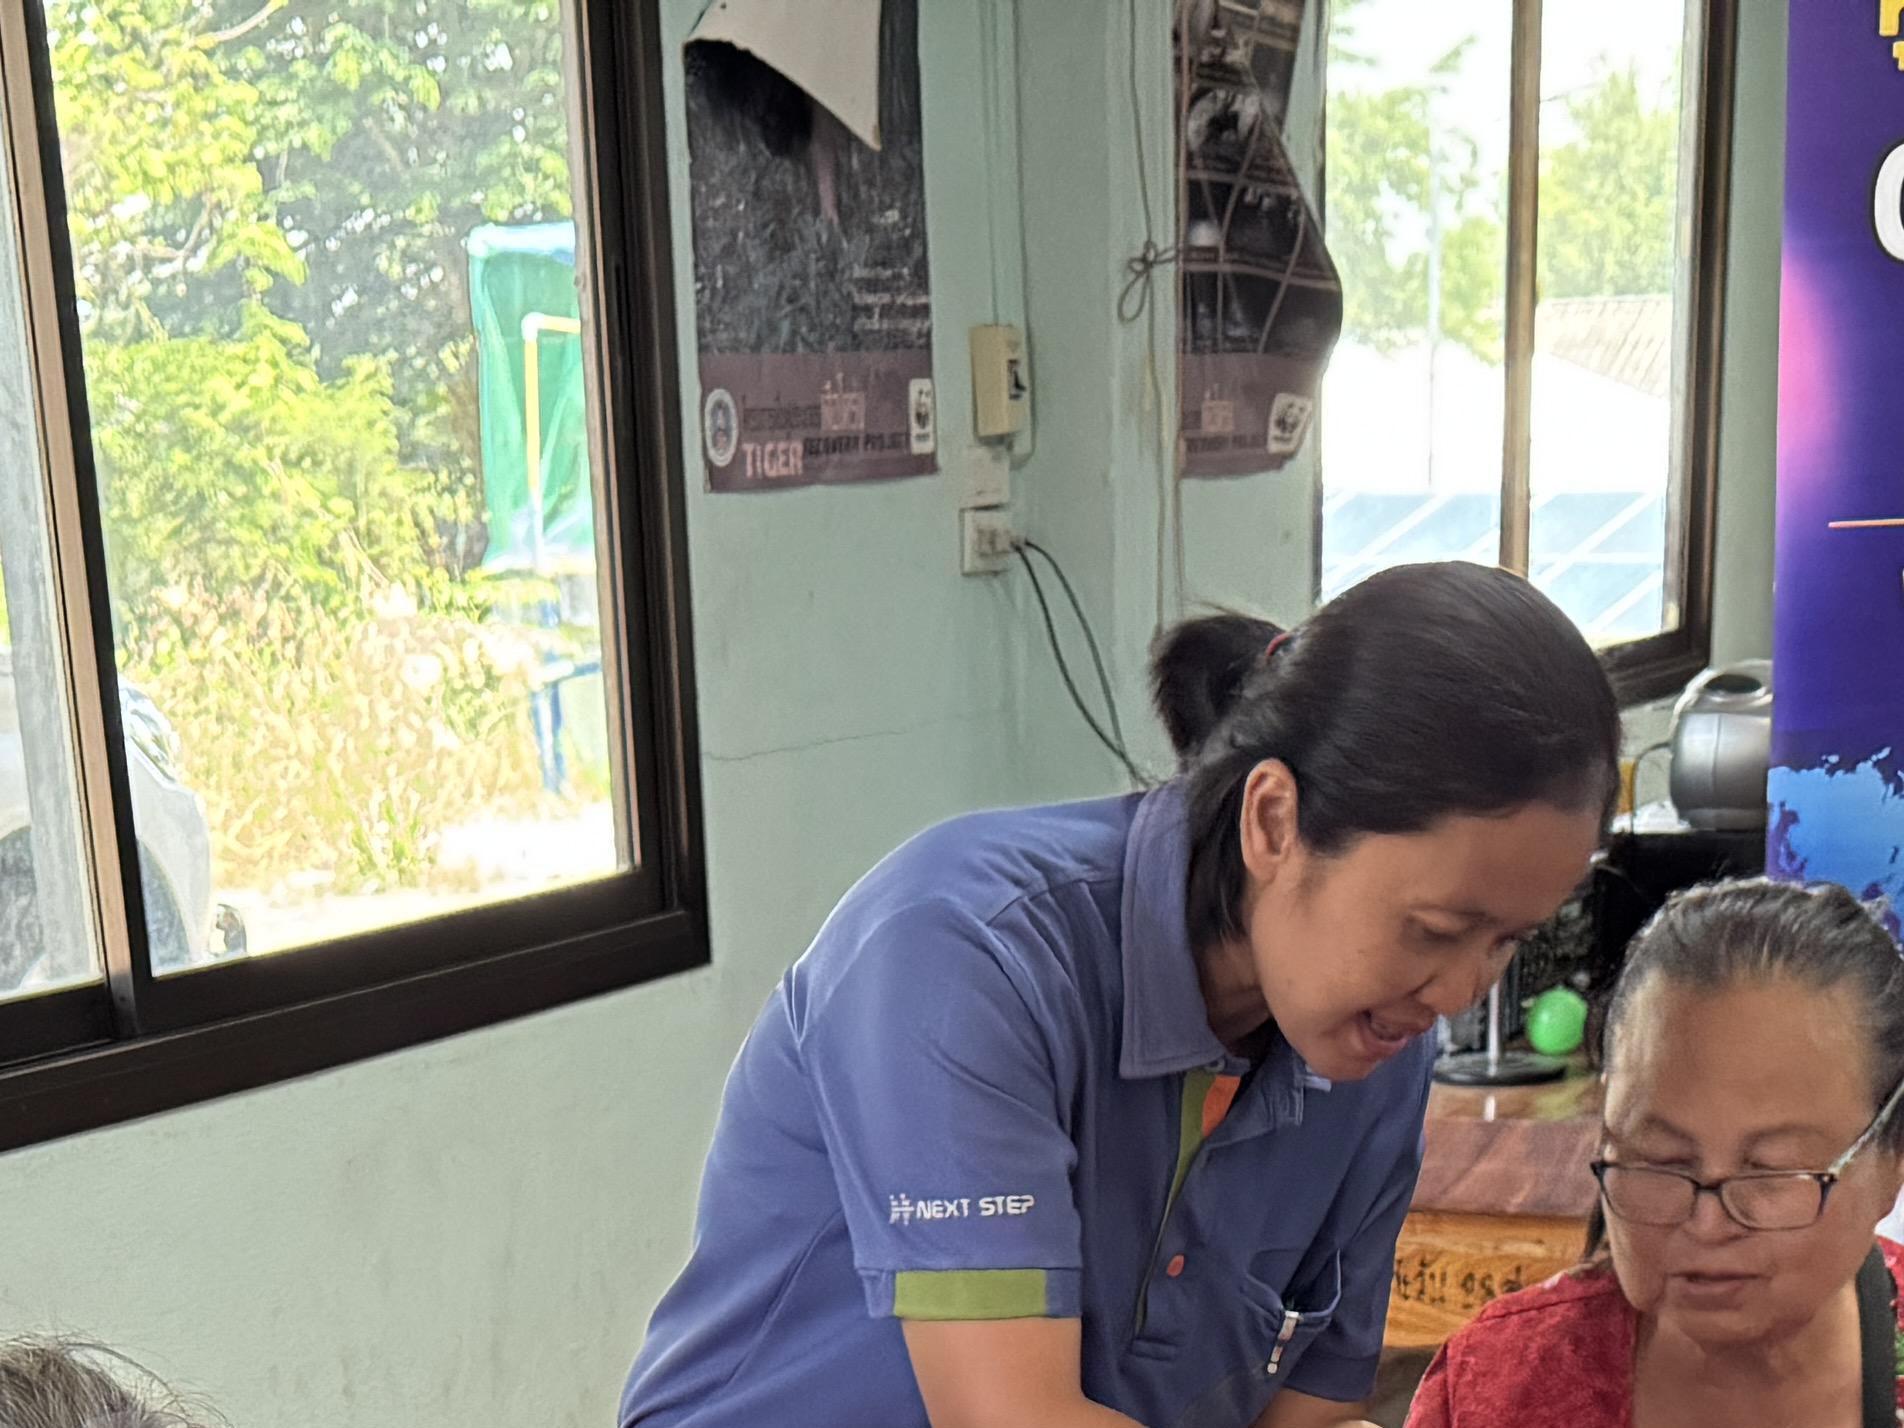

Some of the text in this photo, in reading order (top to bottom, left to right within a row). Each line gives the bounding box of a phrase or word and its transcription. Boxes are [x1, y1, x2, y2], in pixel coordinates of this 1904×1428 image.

[742, 440, 804, 479] TIGER
[916, 1194, 1035, 1220] NEXT STEP
